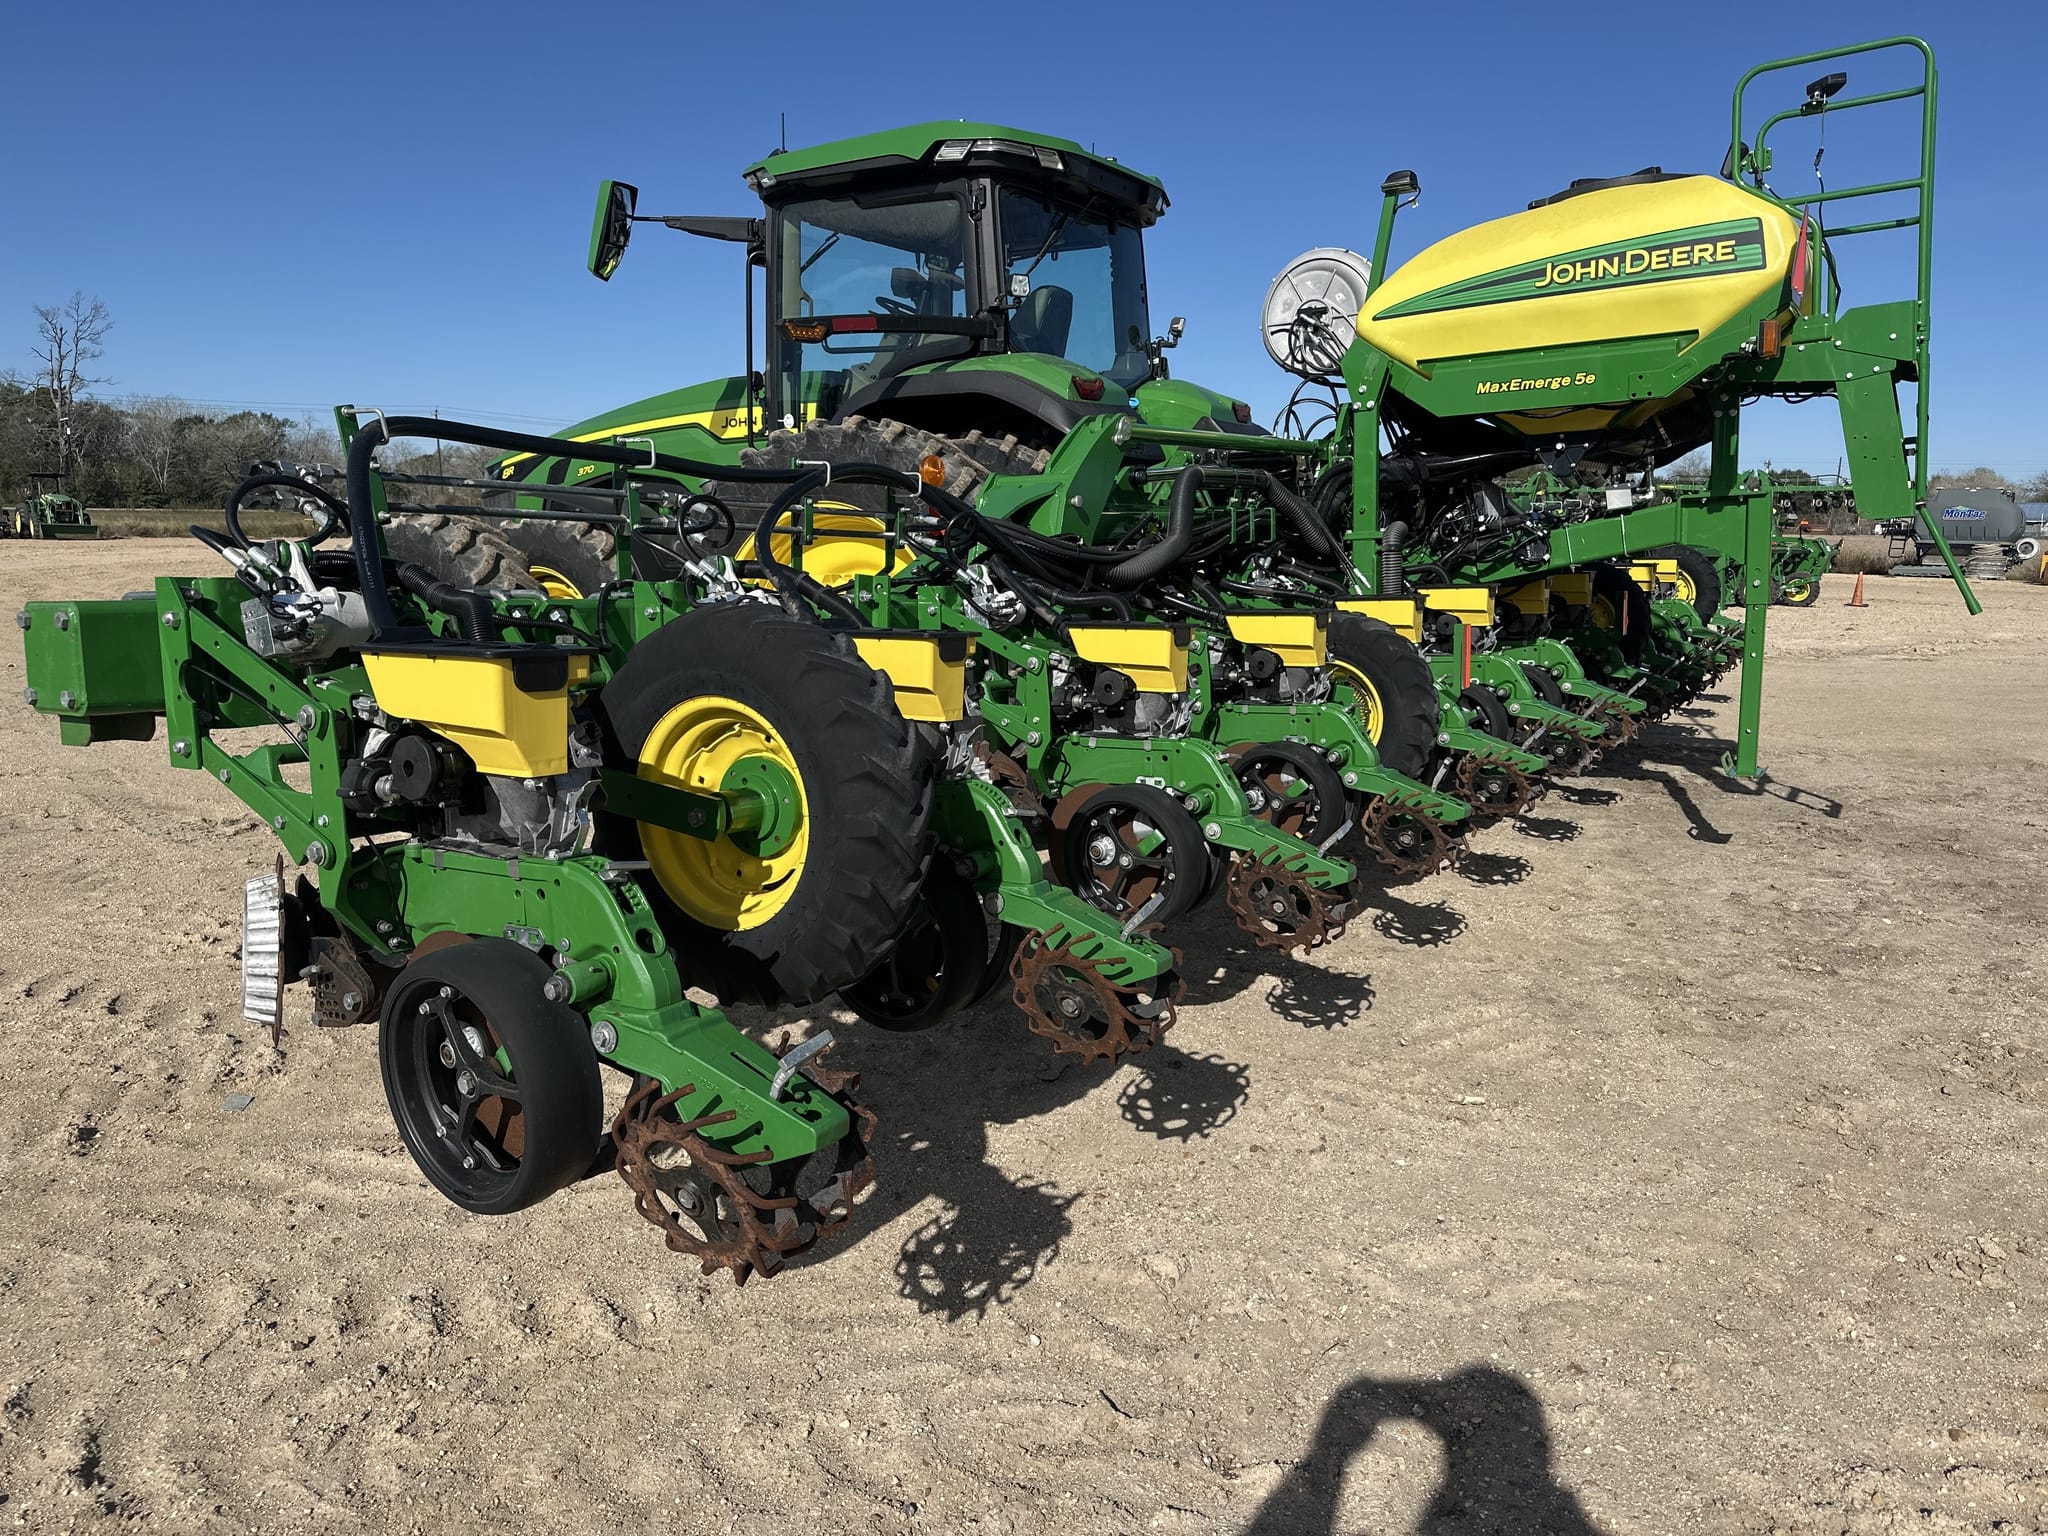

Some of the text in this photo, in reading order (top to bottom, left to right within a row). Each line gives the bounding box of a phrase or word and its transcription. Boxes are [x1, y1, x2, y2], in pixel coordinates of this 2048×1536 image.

[1535, 240, 1737, 288] JOHN DEERE
[1476, 372, 1596, 394] MaxEmerge 5e
[502, 466, 515, 480] 8R
[577, 464, 595, 477] 370
